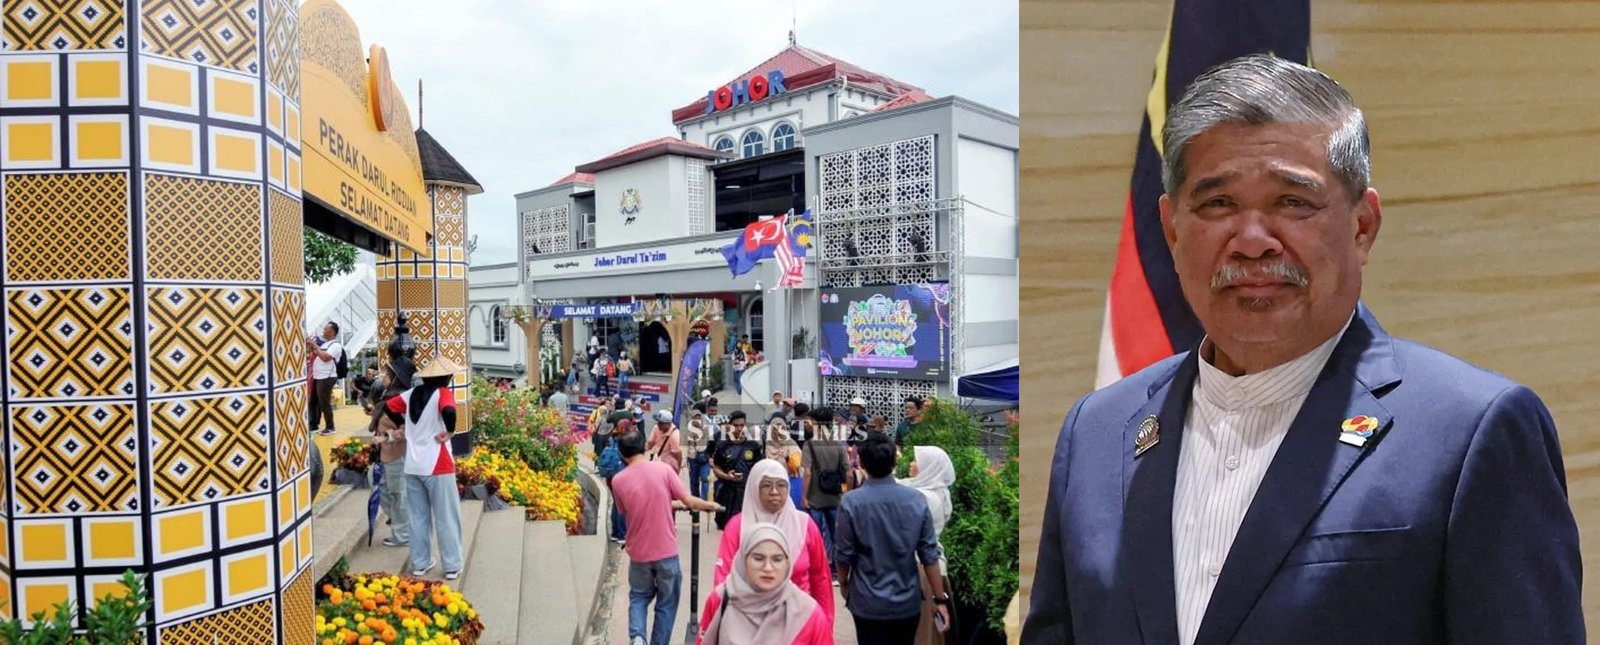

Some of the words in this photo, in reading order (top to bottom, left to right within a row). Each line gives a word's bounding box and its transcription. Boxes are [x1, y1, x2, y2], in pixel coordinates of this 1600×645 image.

[706, 70, 786, 114] JOHOR
[319, 117, 359, 173] PERAK
[362, 155, 389, 196] DARUL
[391, 181, 417, 216] RIDZUAN
[340, 181, 382, 226] SELAMAT
[384, 211, 409, 241] DATANG
[594, 257, 614, 267] Johor
[616, 255, 637, 266] Darul
[639, 251, 667, 263] Ta'zim
[564, 306, 596, 315] SELAMAT
[600, 305, 631, 315] DATANG
[851, 314, 907, 326] PAVILION
